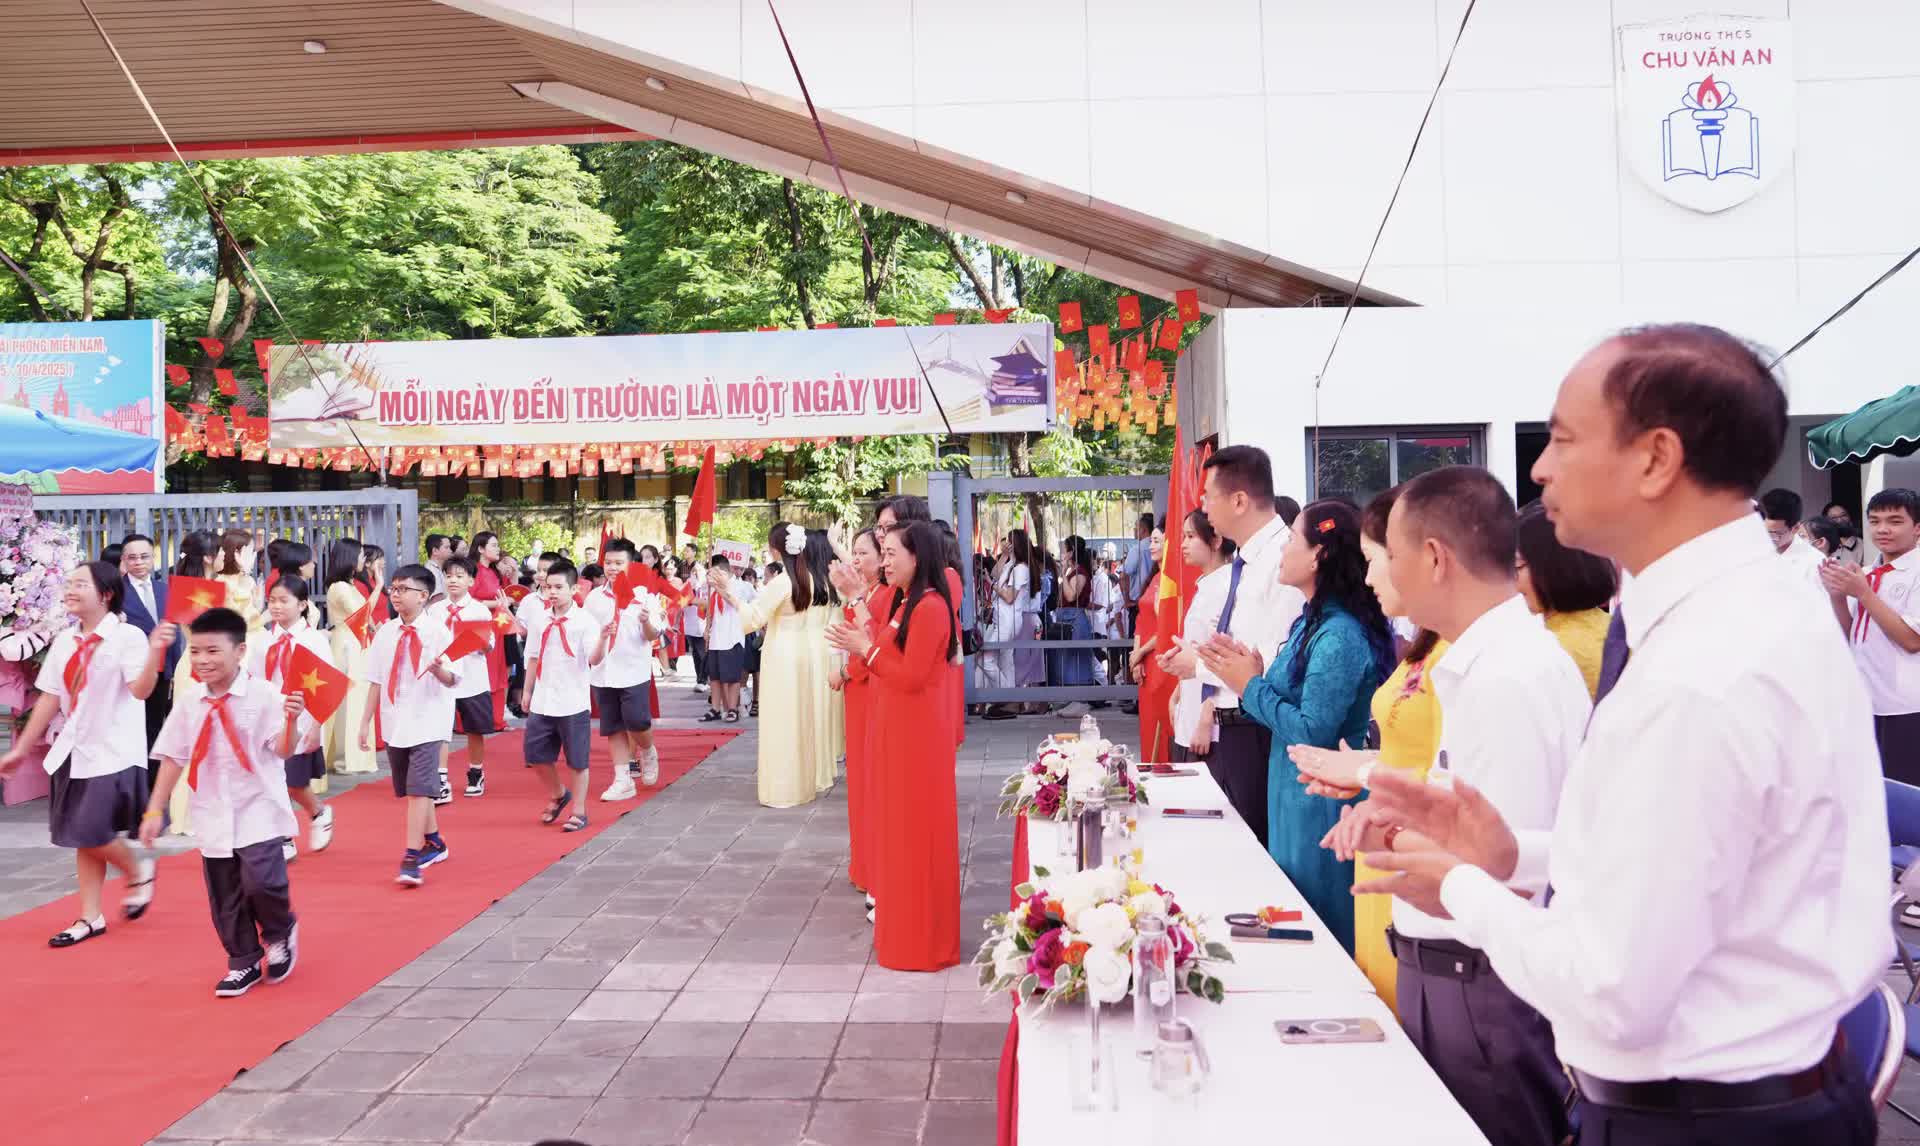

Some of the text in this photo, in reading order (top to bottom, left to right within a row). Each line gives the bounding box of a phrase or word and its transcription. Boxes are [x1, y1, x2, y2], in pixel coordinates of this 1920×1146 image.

[1718, 30, 1753, 40] THCS
[1642, 46, 1773, 69] CHU VĂN AN
[379, 371, 921, 424] MỖI NGÀY ĐẾN TRƯỜNG LÀ MỘT NGÀY VUI
